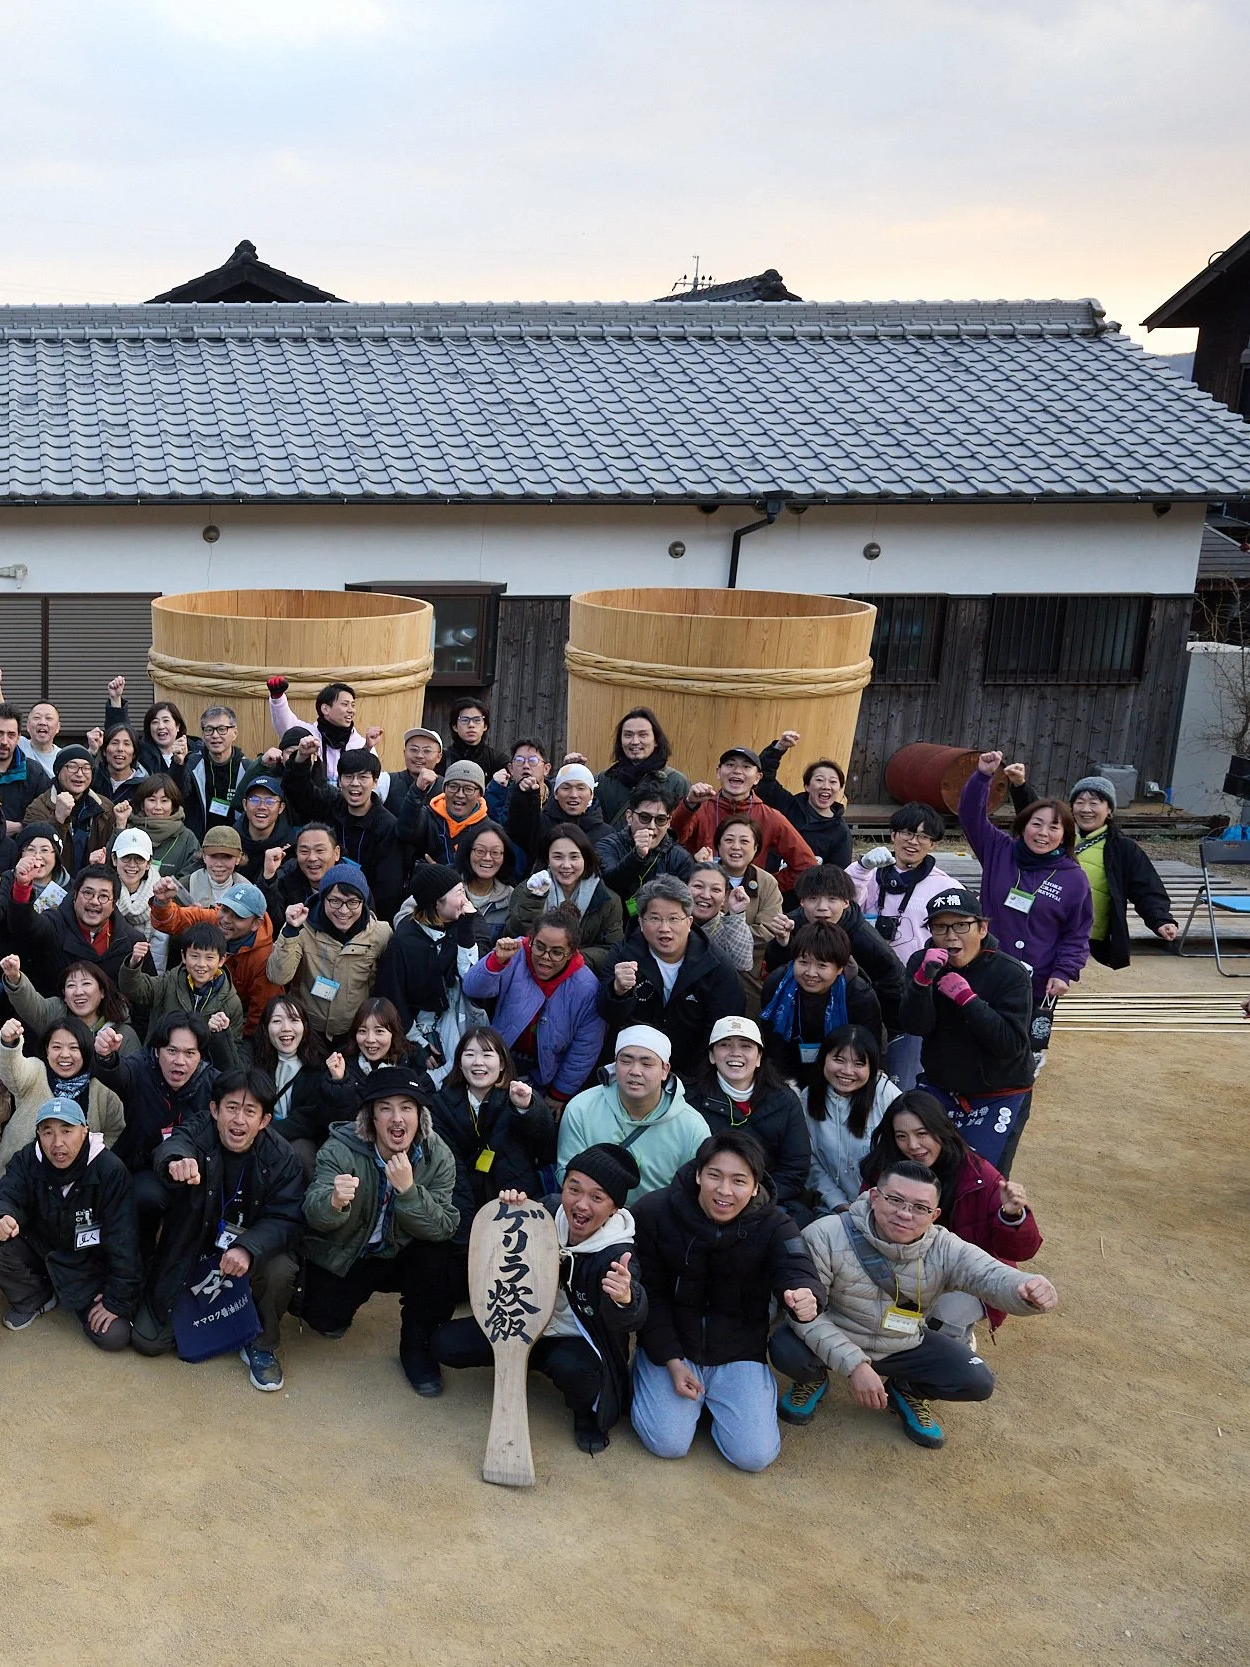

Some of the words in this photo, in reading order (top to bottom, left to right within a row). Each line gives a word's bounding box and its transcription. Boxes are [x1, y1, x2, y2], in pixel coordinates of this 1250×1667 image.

[1040, 885, 1061, 895] CRAFT
[1043, 880, 1063, 891] KIOKE
[933, 894, 961, 908] 木桶
[1037, 888, 1062, 903] REVIVAL
[484, 1201, 546, 1345] ゲリラ炊飯
